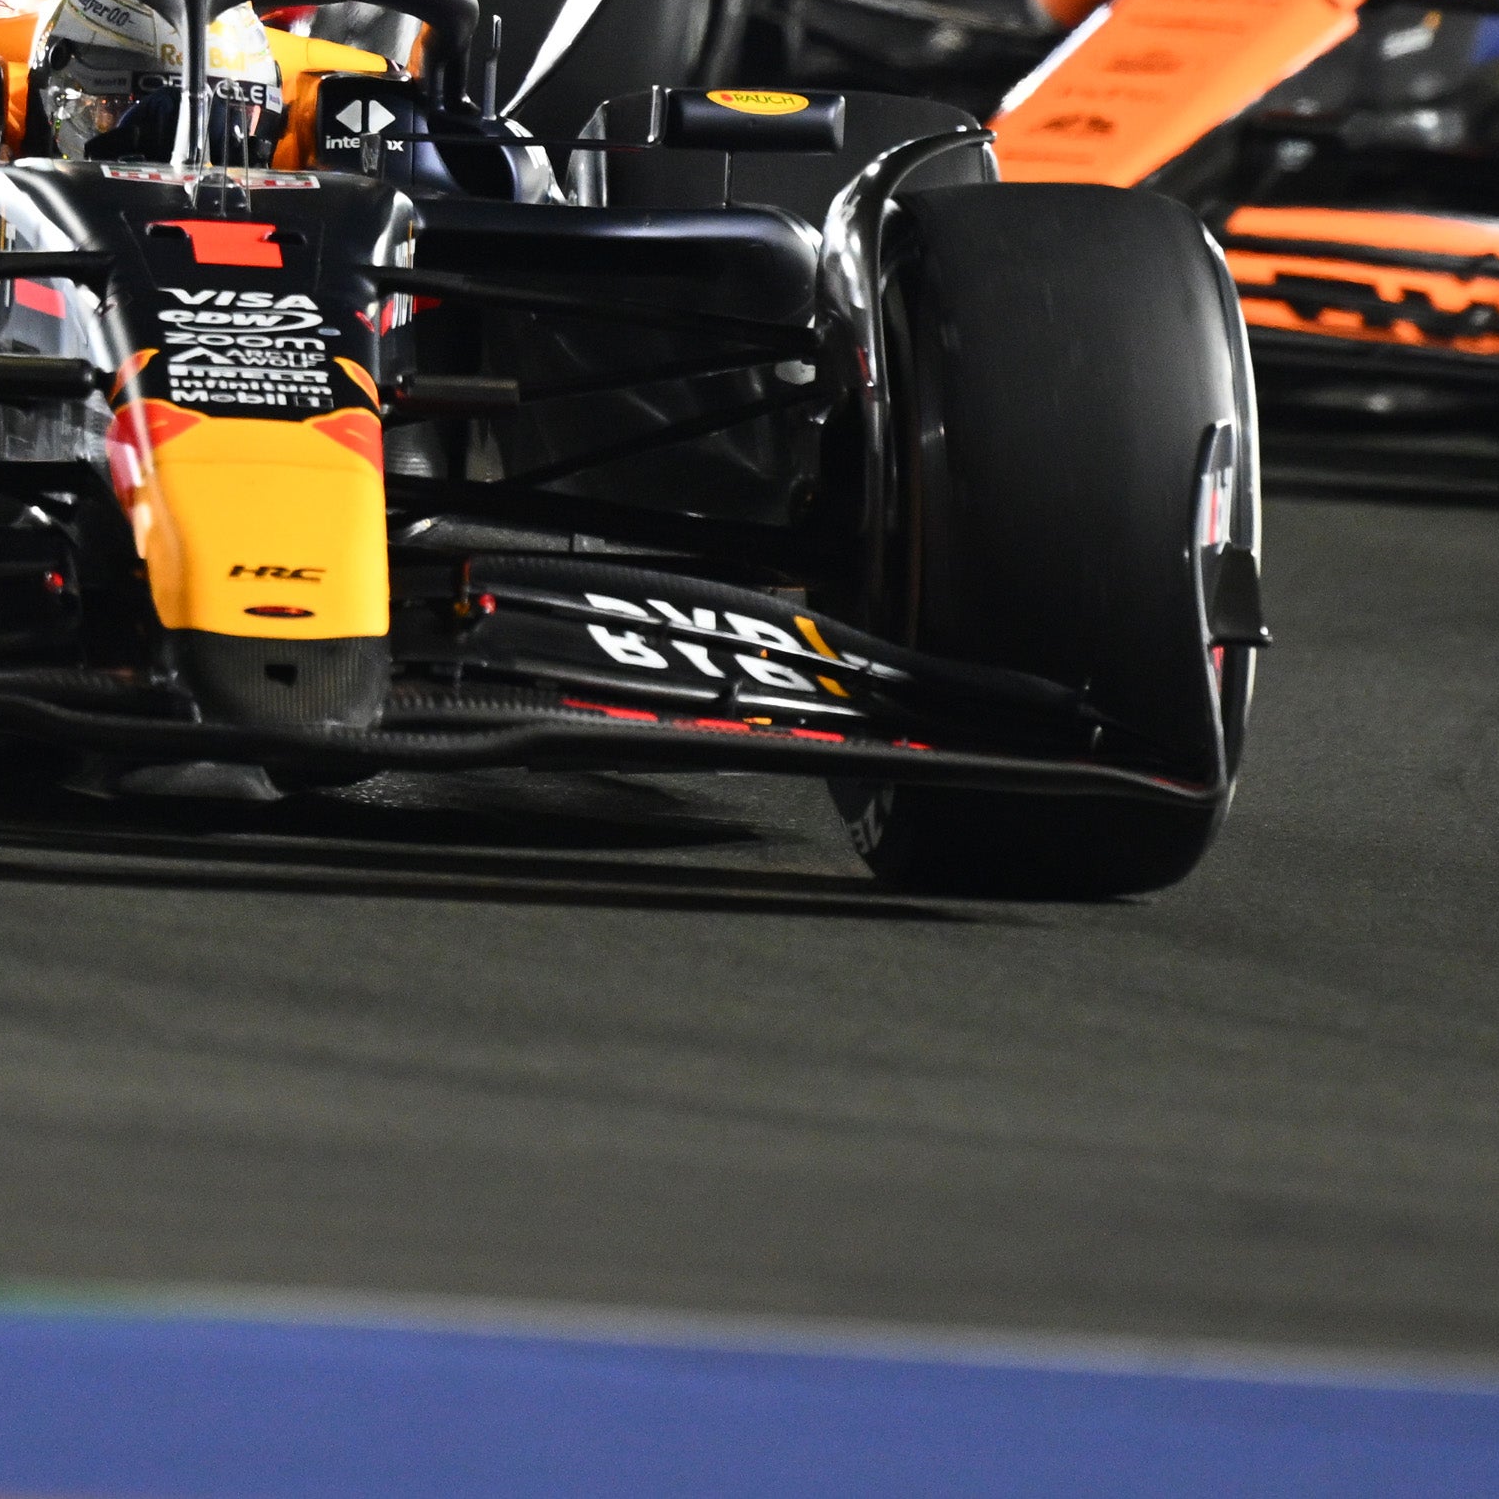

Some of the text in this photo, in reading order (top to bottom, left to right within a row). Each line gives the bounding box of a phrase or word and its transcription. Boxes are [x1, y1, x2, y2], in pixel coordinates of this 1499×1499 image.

[733, 93, 795, 106] RAUCH
[158, 287, 319, 310] VISA
[157, 309, 285, 328] CDW
[226, 349, 326, 363] ARCTIC
[240, 356, 317, 368] WOLF
[171, 390, 287, 406] Mobil
[229, 565, 327, 582] HRC
